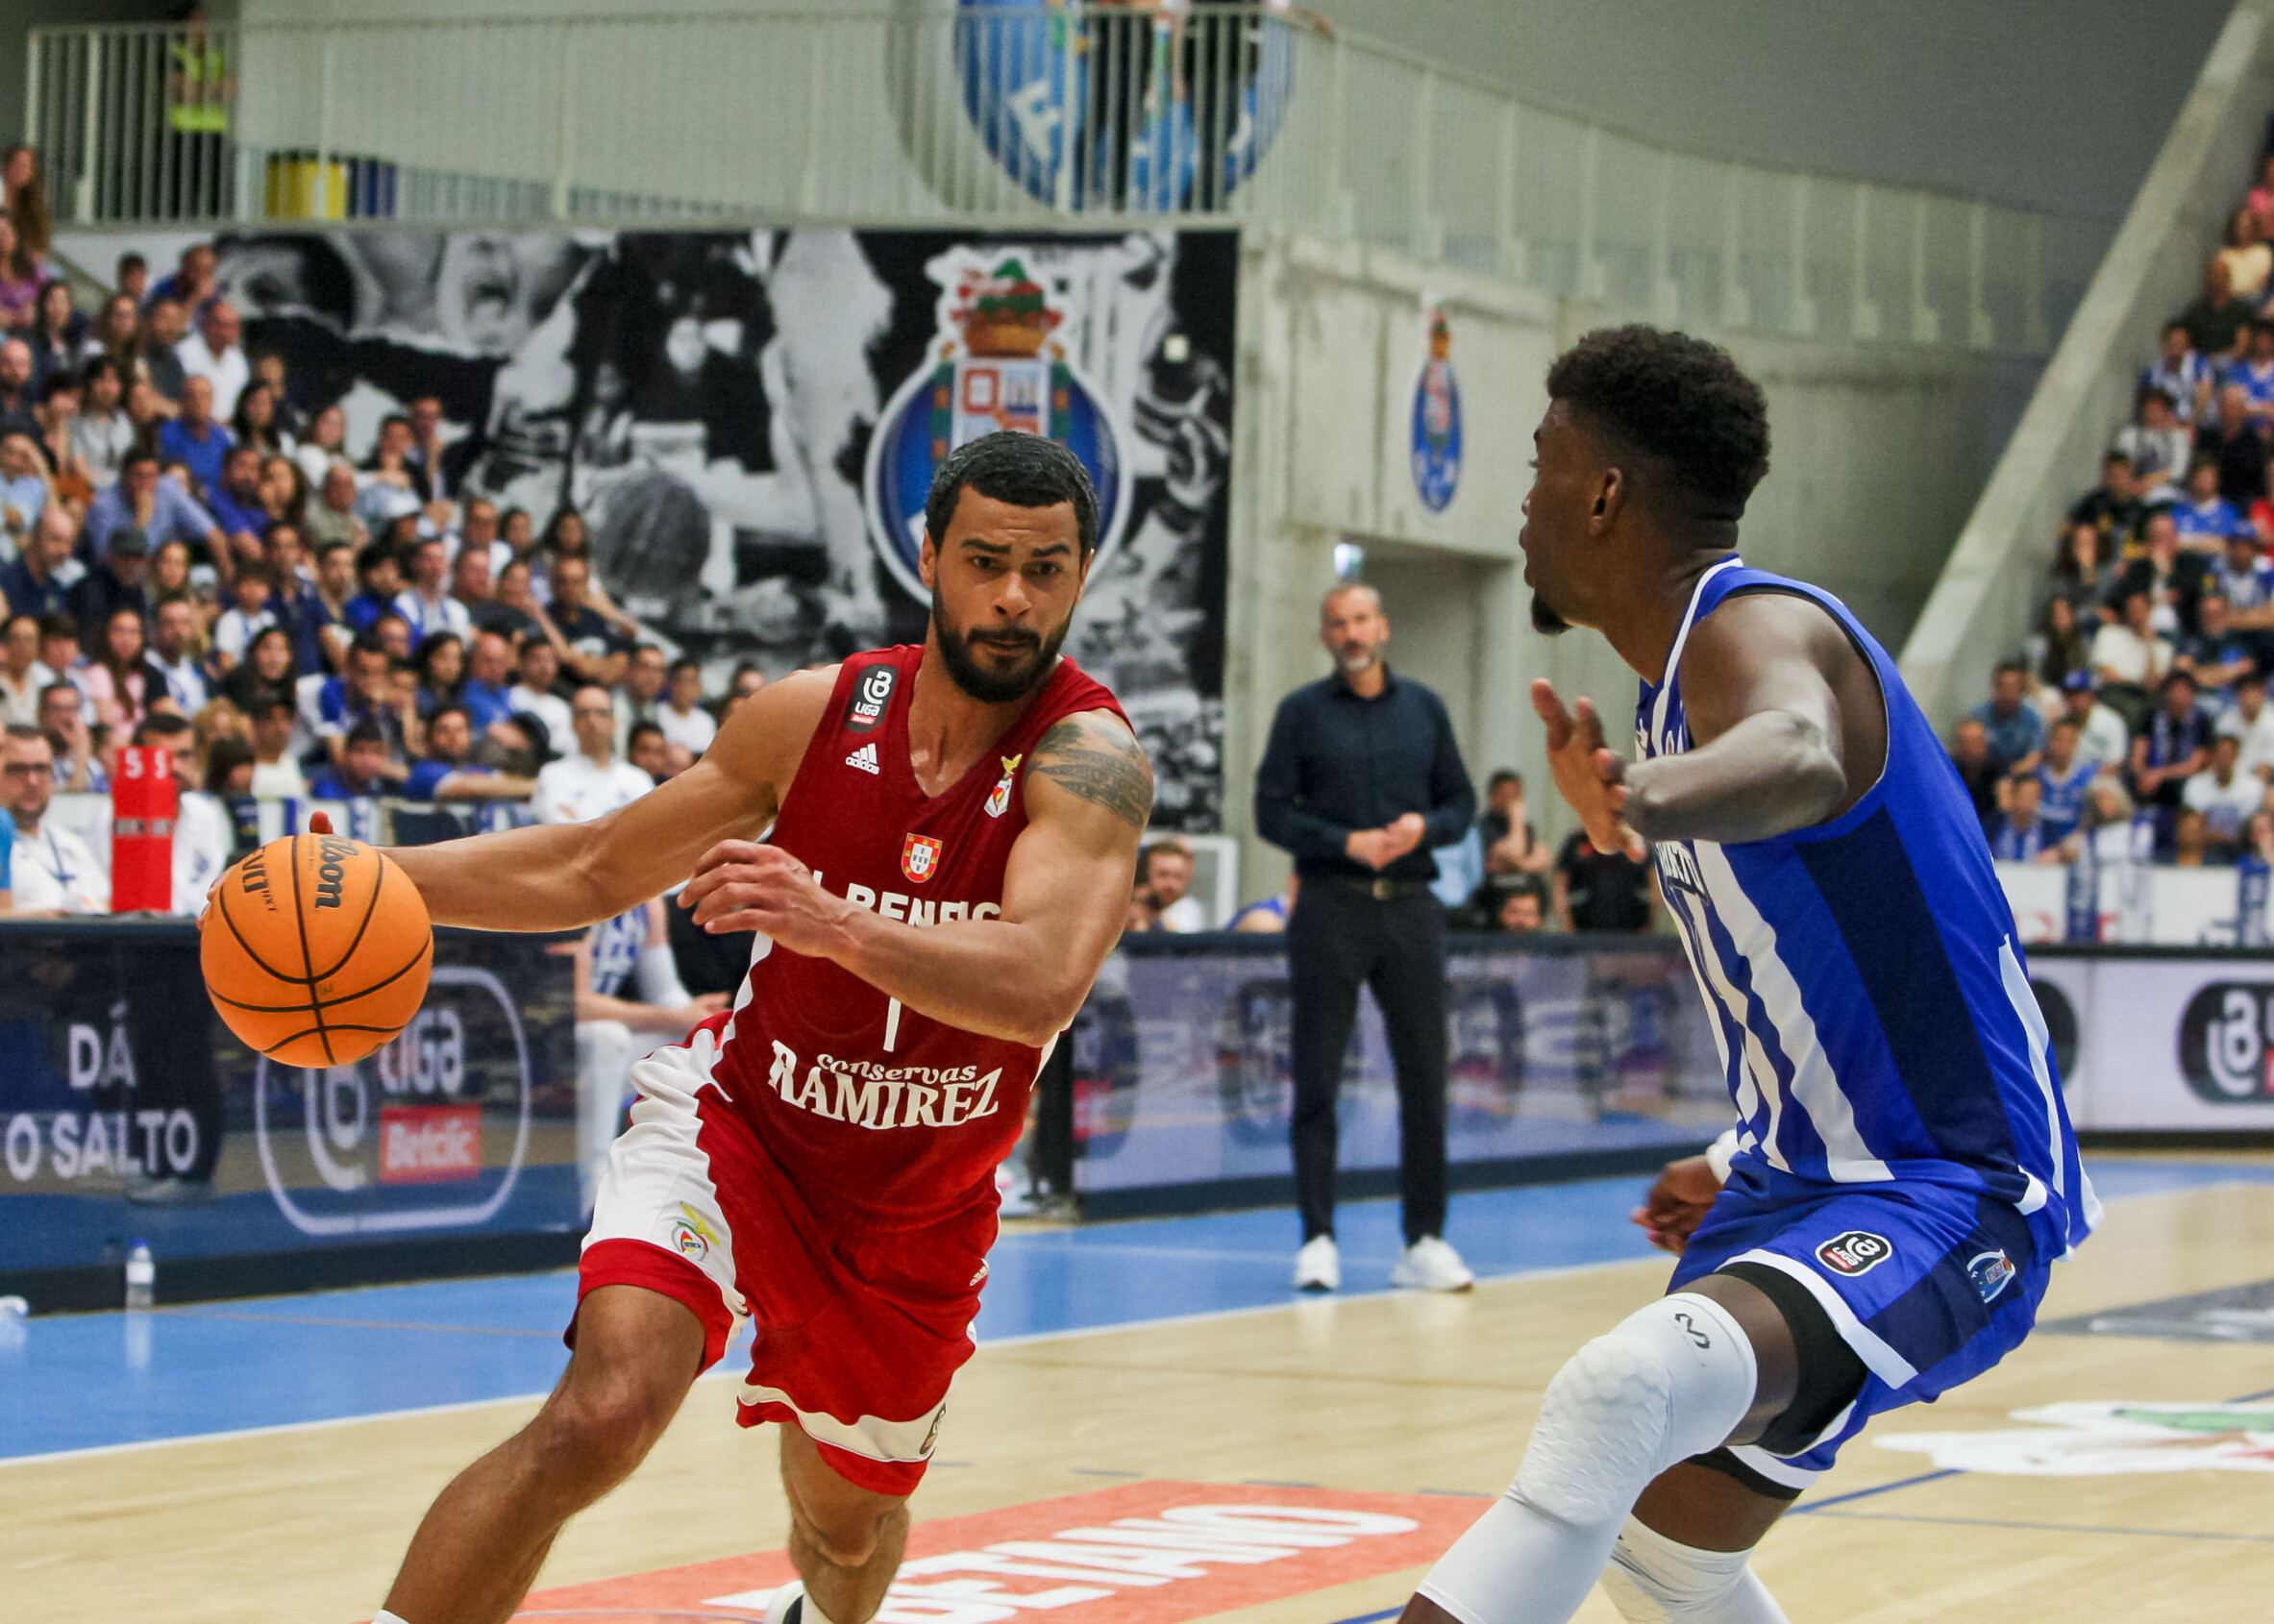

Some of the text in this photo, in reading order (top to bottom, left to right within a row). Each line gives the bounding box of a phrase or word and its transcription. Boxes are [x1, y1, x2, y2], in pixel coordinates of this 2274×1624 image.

[68, 1002, 136, 1090] DÁ
[768, 1039, 1003, 1131] RAMIREZ
[817, 1053, 977, 1085] conservas
[6, 1108, 198, 1181] O SALTO
